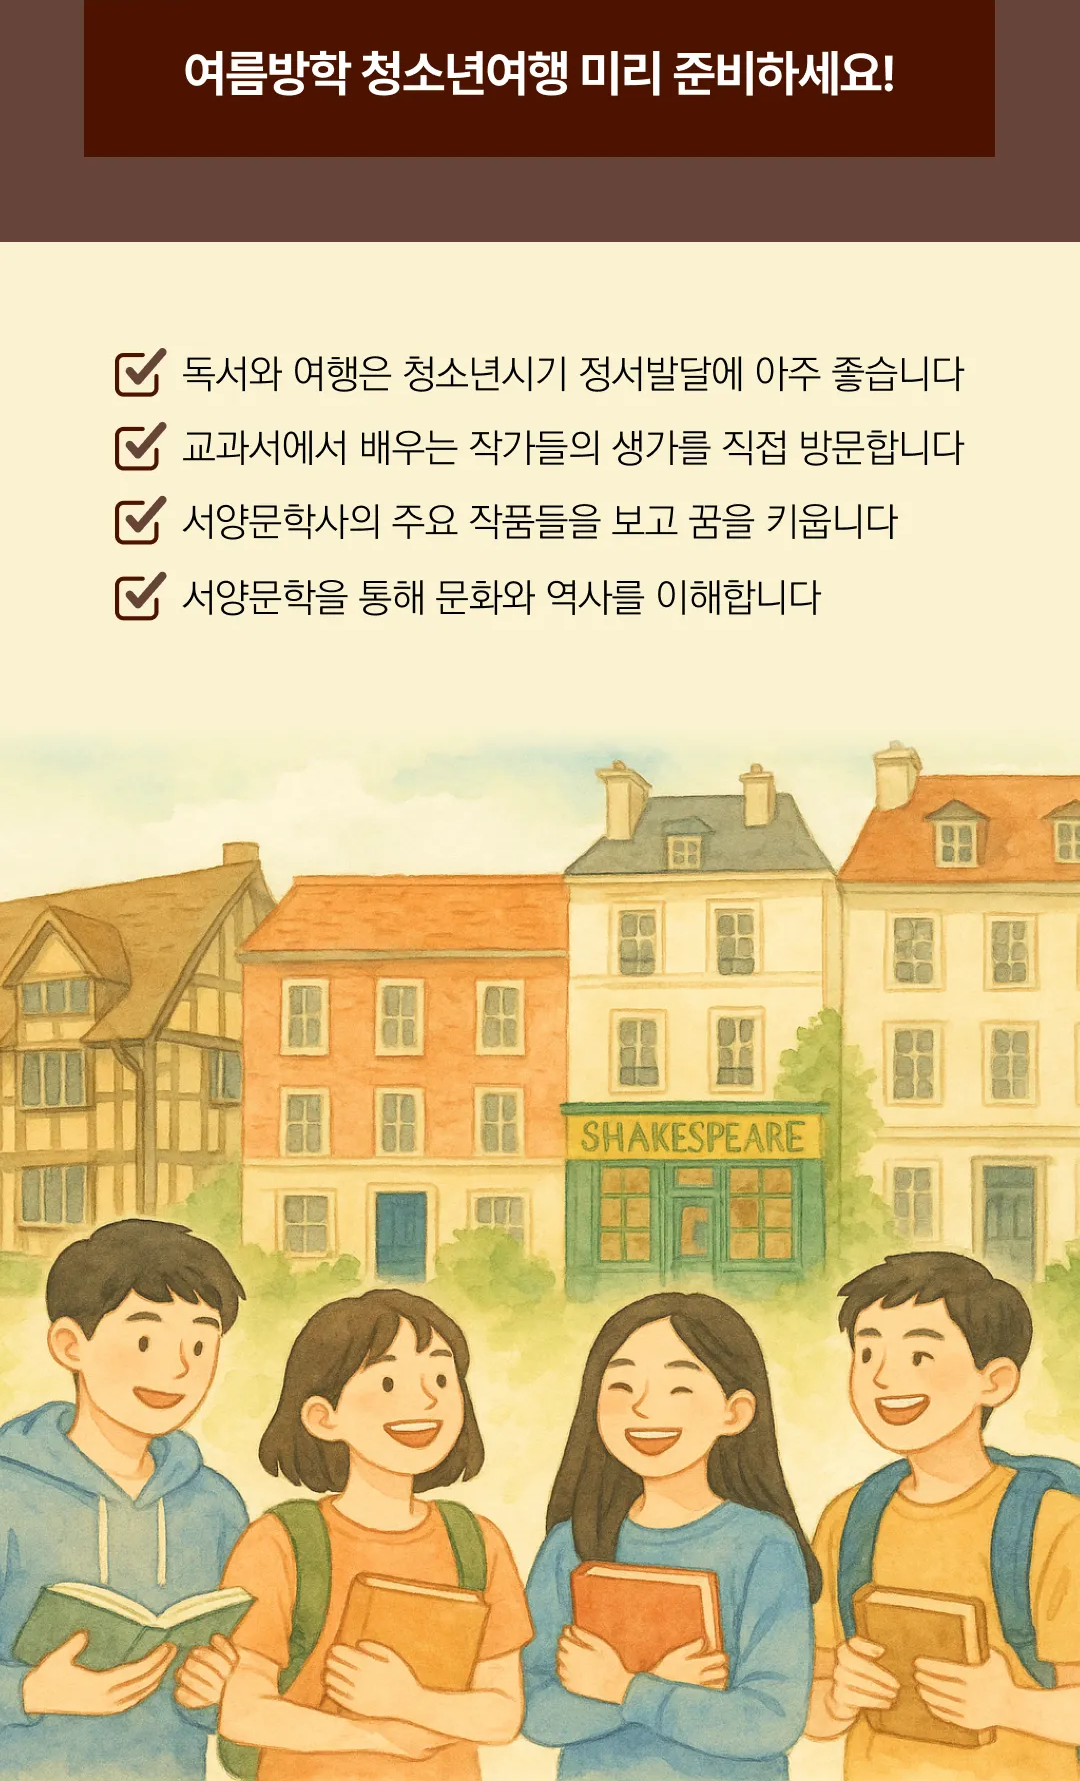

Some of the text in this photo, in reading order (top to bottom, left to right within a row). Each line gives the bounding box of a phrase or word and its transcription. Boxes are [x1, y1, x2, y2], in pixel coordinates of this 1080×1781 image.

[185, 50, 893, 96] 여름방학 청소년여행 미리 준비하세요!
[183, 356, 965, 392] 독서와 여행은 청소년시기 정서발달에 아주 좋습니다
[183, 430, 965, 466] 교과서에서 배우는 작가들의 생가를 직접 방문합니다
[182, 504, 898, 540] 서양문학사의 주요 작품들을 보고 꿈을 키웁니다
[182, 580, 822, 616] 서양문학을 통해 문화와 역사를 이해합니다
[581, 1120, 805, 1152] SHAKESPEARE
